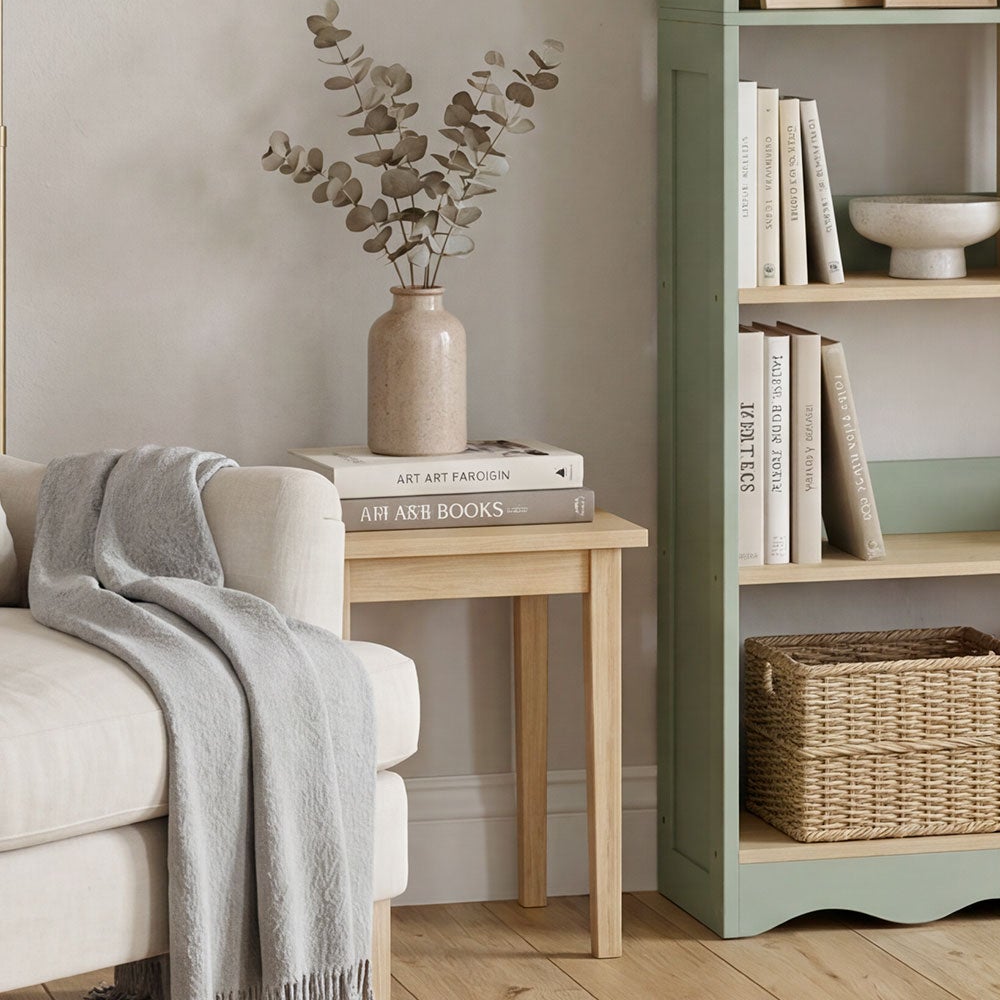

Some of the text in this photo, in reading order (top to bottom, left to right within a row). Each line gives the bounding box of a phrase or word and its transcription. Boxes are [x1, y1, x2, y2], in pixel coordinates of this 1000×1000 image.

[397, 470, 510, 484] ART ART FAROIGIN
[437, 501, 504, 520] BOOKS
